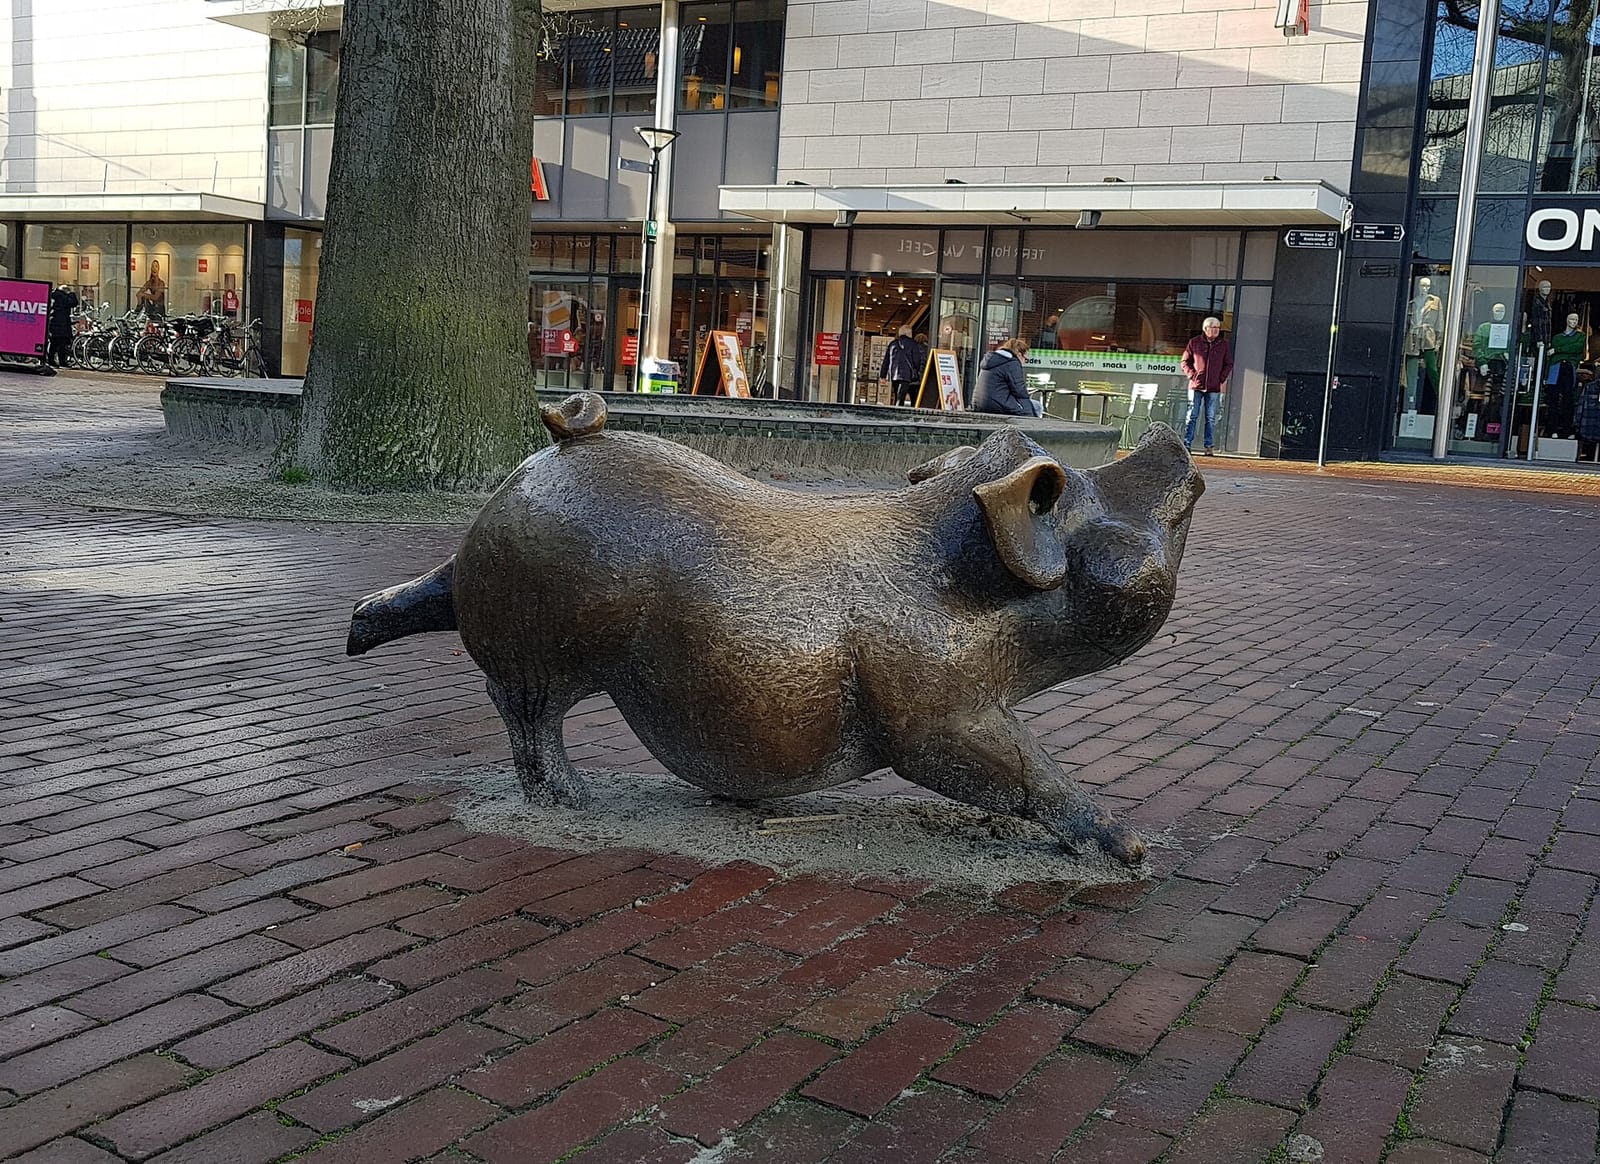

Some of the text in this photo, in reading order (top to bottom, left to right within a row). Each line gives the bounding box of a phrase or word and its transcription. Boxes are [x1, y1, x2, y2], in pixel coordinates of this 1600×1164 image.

[0, 299, 48, 315] HALVE
[1068, 360, 1095, 368] sappen
[1147, 364, 1176, 372] hotdog
